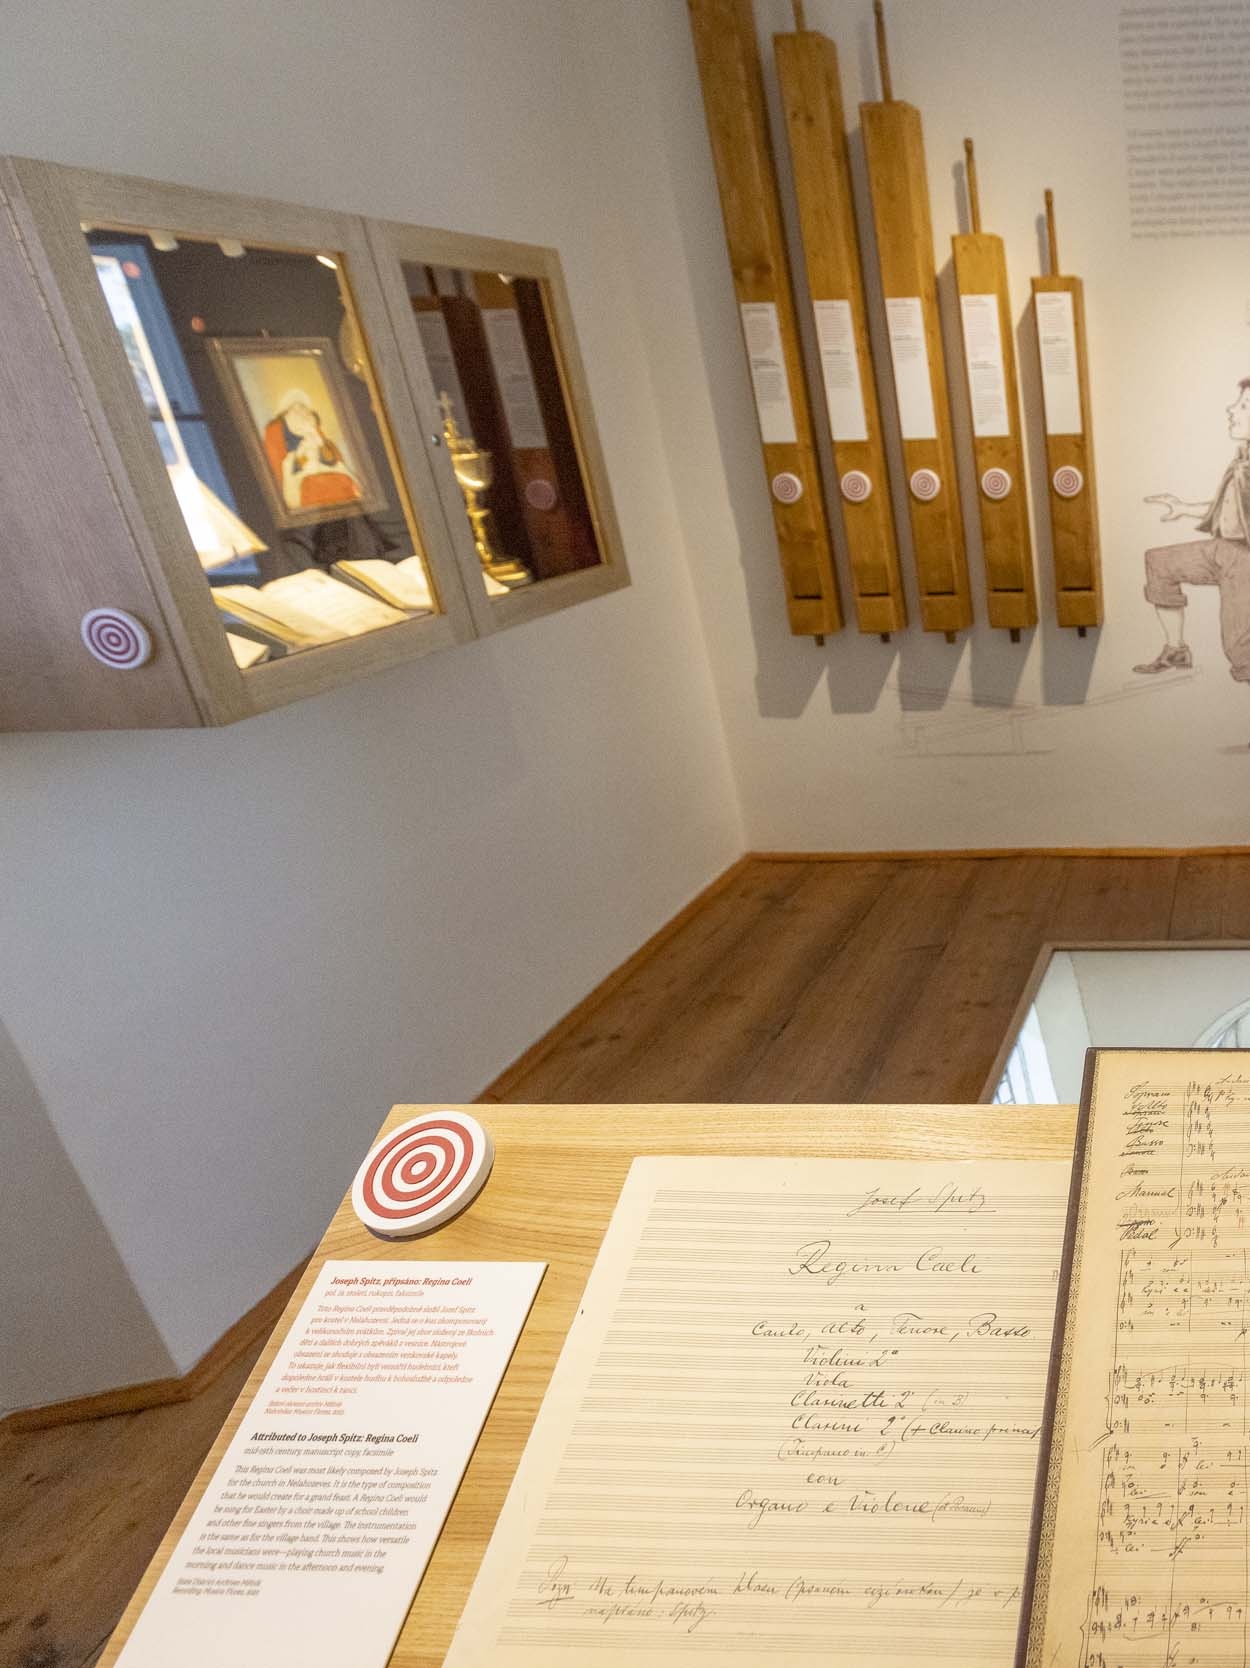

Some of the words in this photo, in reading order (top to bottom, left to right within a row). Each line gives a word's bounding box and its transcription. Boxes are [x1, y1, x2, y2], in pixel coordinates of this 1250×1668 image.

[788, 1240, 904, 1286] Regina
[330, 1276, 359, 1287] Joseph
[422, 1277, 450, 1288] Regina
[451, 1278, 472, 1286] Coeli
[804, 1372, 850, 1388] Viola
[250, 1432, 296, 1441] Attributed
[297, 1433, 307, 1441] to
[307, 1433, 337, 1444] Joseph
[338, 1433, 364, 1445] Spitz:
[365, 1434, 395, 1445] Regina
[396, 1434, 420, 1442] Coeli
